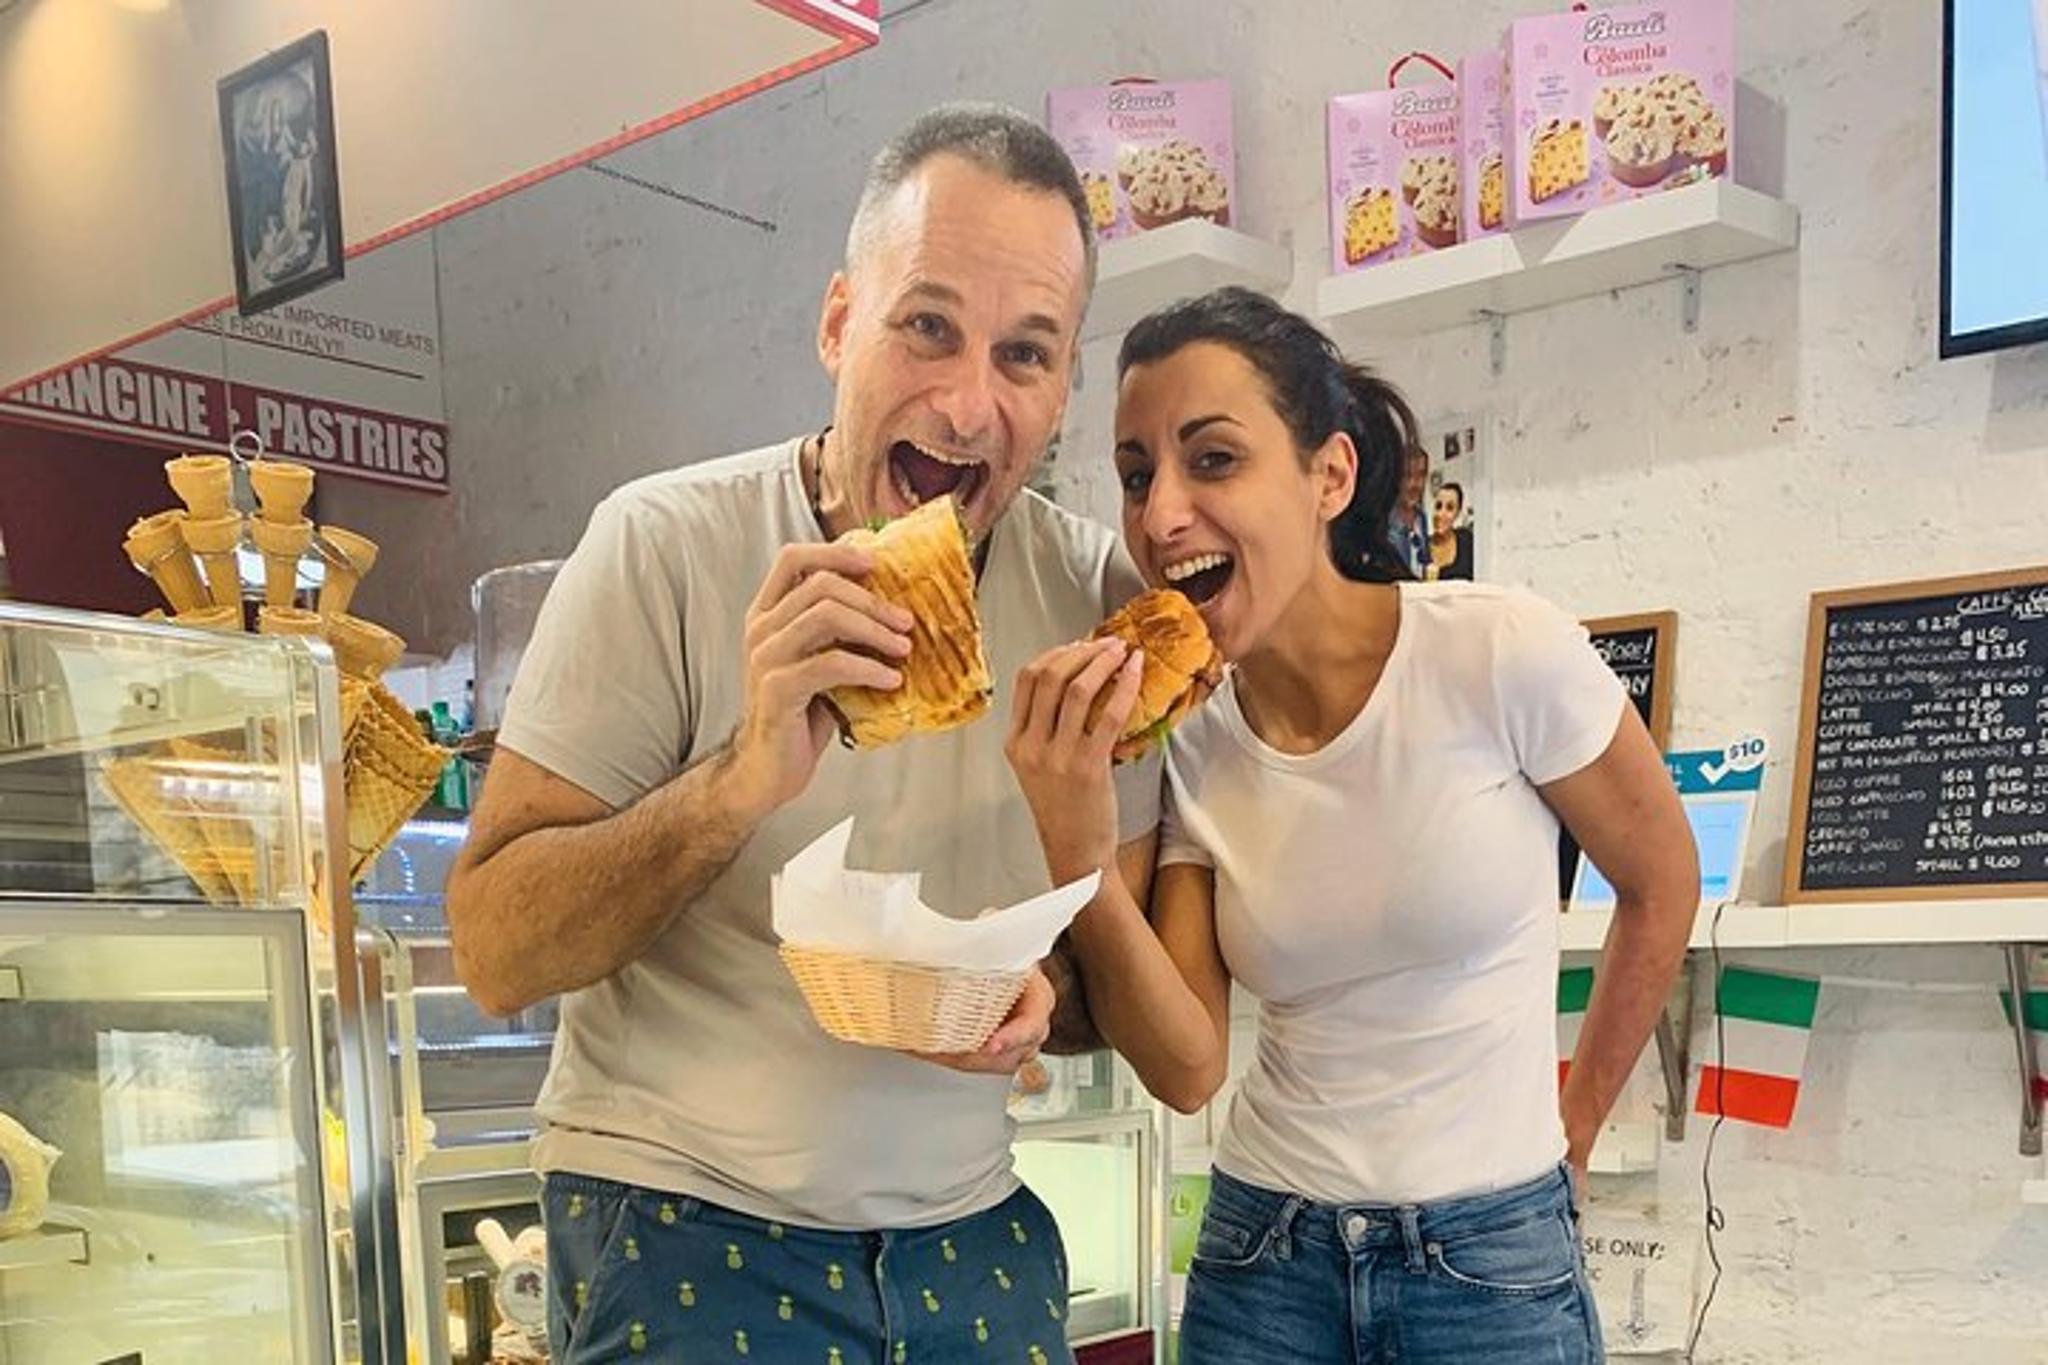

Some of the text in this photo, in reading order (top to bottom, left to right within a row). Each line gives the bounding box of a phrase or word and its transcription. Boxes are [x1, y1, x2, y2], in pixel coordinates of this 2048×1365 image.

[230, 315, 284, 341] FROM
[285, 307, 375, 340] IMPORTED
[379, 326, 433, 356] MEATS
[257, 396, 445, 479] PASTRIES
[1821, 706, 1861, 720] LATTE
[1819, 720, 1873, 738] COFFEE
[1728, 738, 1765, 760] $10
